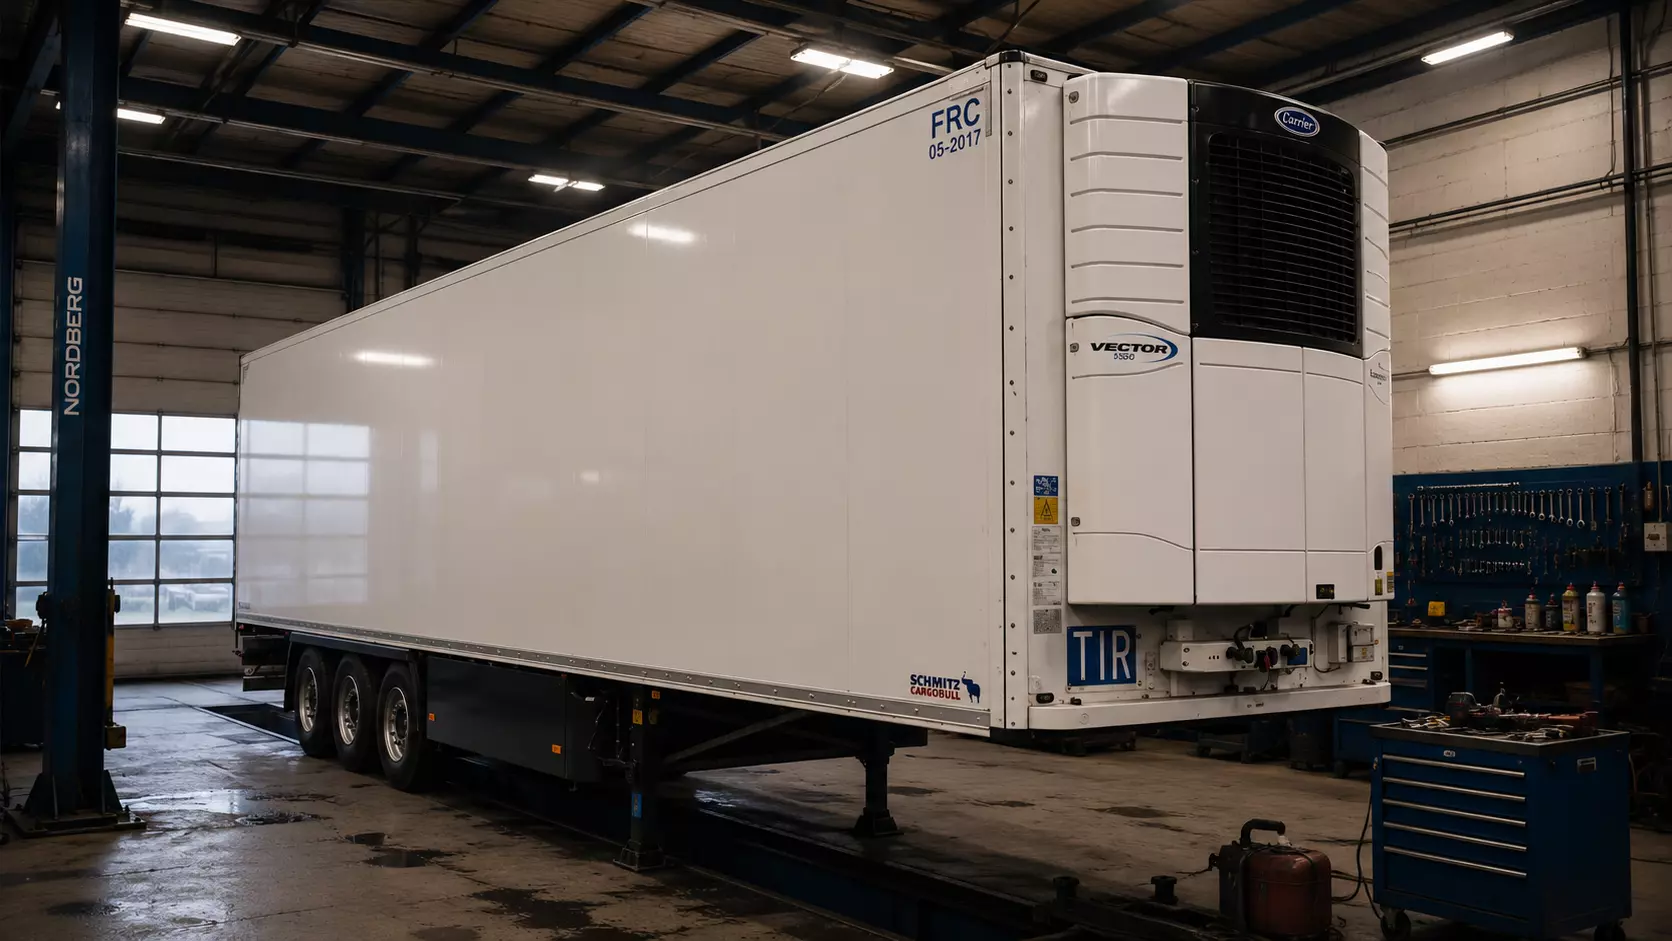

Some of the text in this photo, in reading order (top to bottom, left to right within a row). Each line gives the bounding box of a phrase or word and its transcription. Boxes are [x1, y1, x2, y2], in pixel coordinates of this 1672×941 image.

[931, 98, 980, 139] FRC
[1282, 111, 1314, 130] Carrier
[929, 129, 981, 160] 05-2017
[64, 276, 83, 416] NORDBERG
[1090, 342, 1168, 354] VECTOR
[1073, 630, 1131, 680] TIR
[910, 674, 960, 690] SCHMITZ
[910, 686, 961, 701] CARGOBULL
